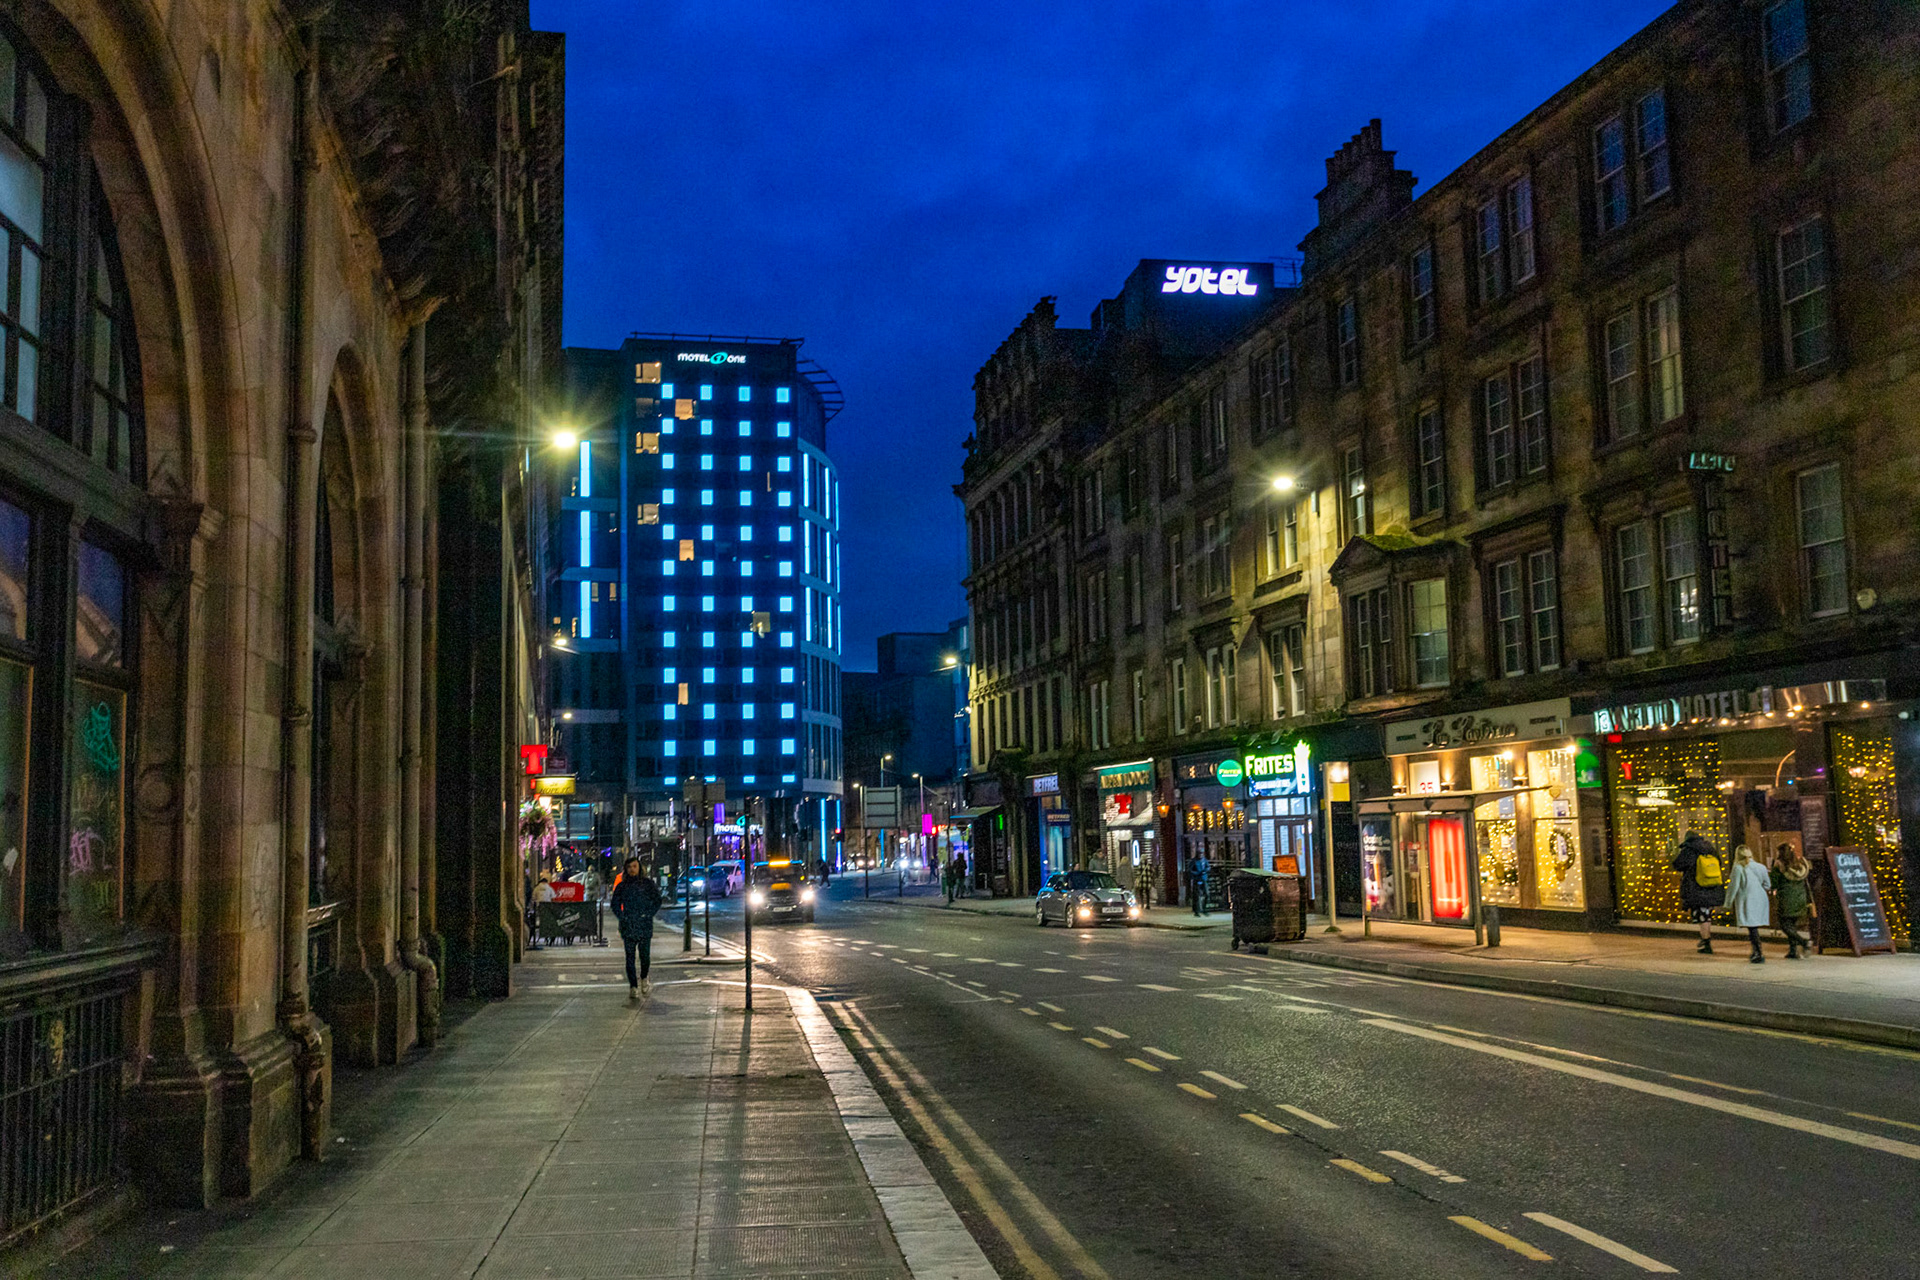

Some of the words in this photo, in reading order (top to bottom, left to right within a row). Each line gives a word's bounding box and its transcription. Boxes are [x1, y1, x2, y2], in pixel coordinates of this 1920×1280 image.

[677, 353, 710, 363] MOTEL
[726, 354, 747, 364] ONE
[1680, 688, 1744, 722] HOTEL
[1245, 754, 1294, 776] FRITES
